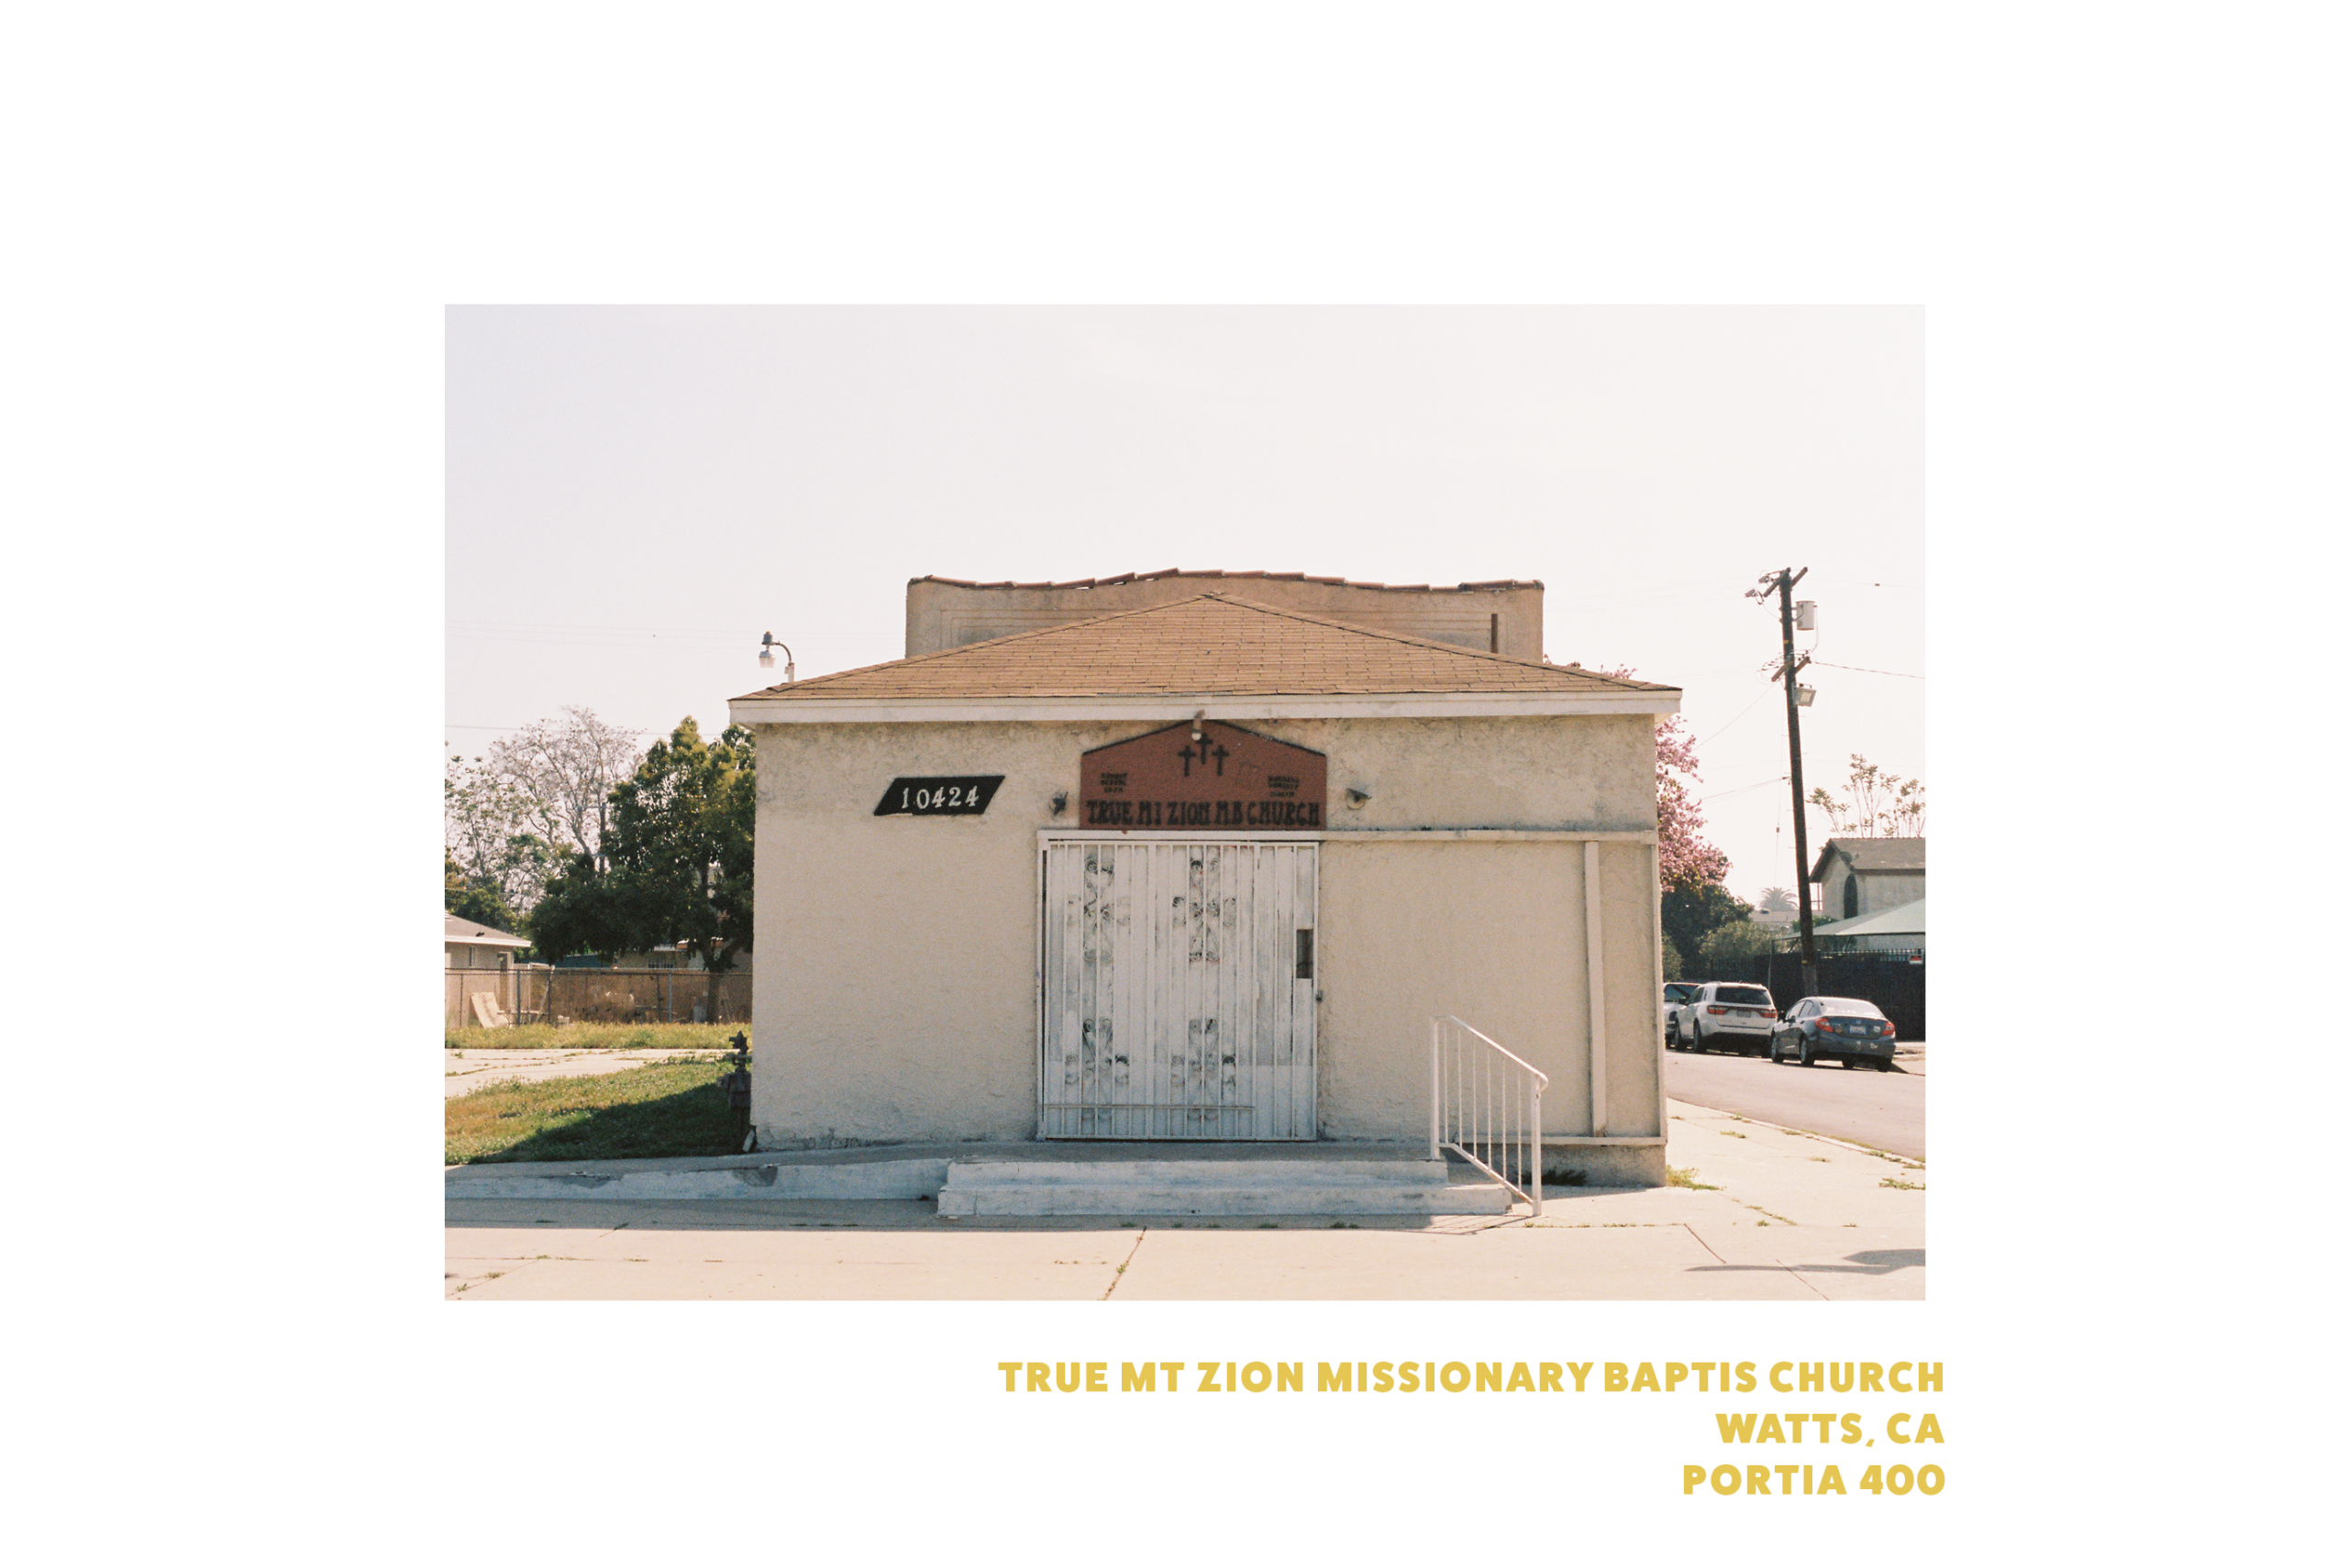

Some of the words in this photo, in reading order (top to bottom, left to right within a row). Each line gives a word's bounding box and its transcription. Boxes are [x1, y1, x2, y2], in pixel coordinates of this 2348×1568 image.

[901, 785, 980, 810] 10424
[1086, 800, 1134, 825] TRUE
[1167, 801, 1210, 826] ZION
[1247, 801, 1321, 827] CHURCH
